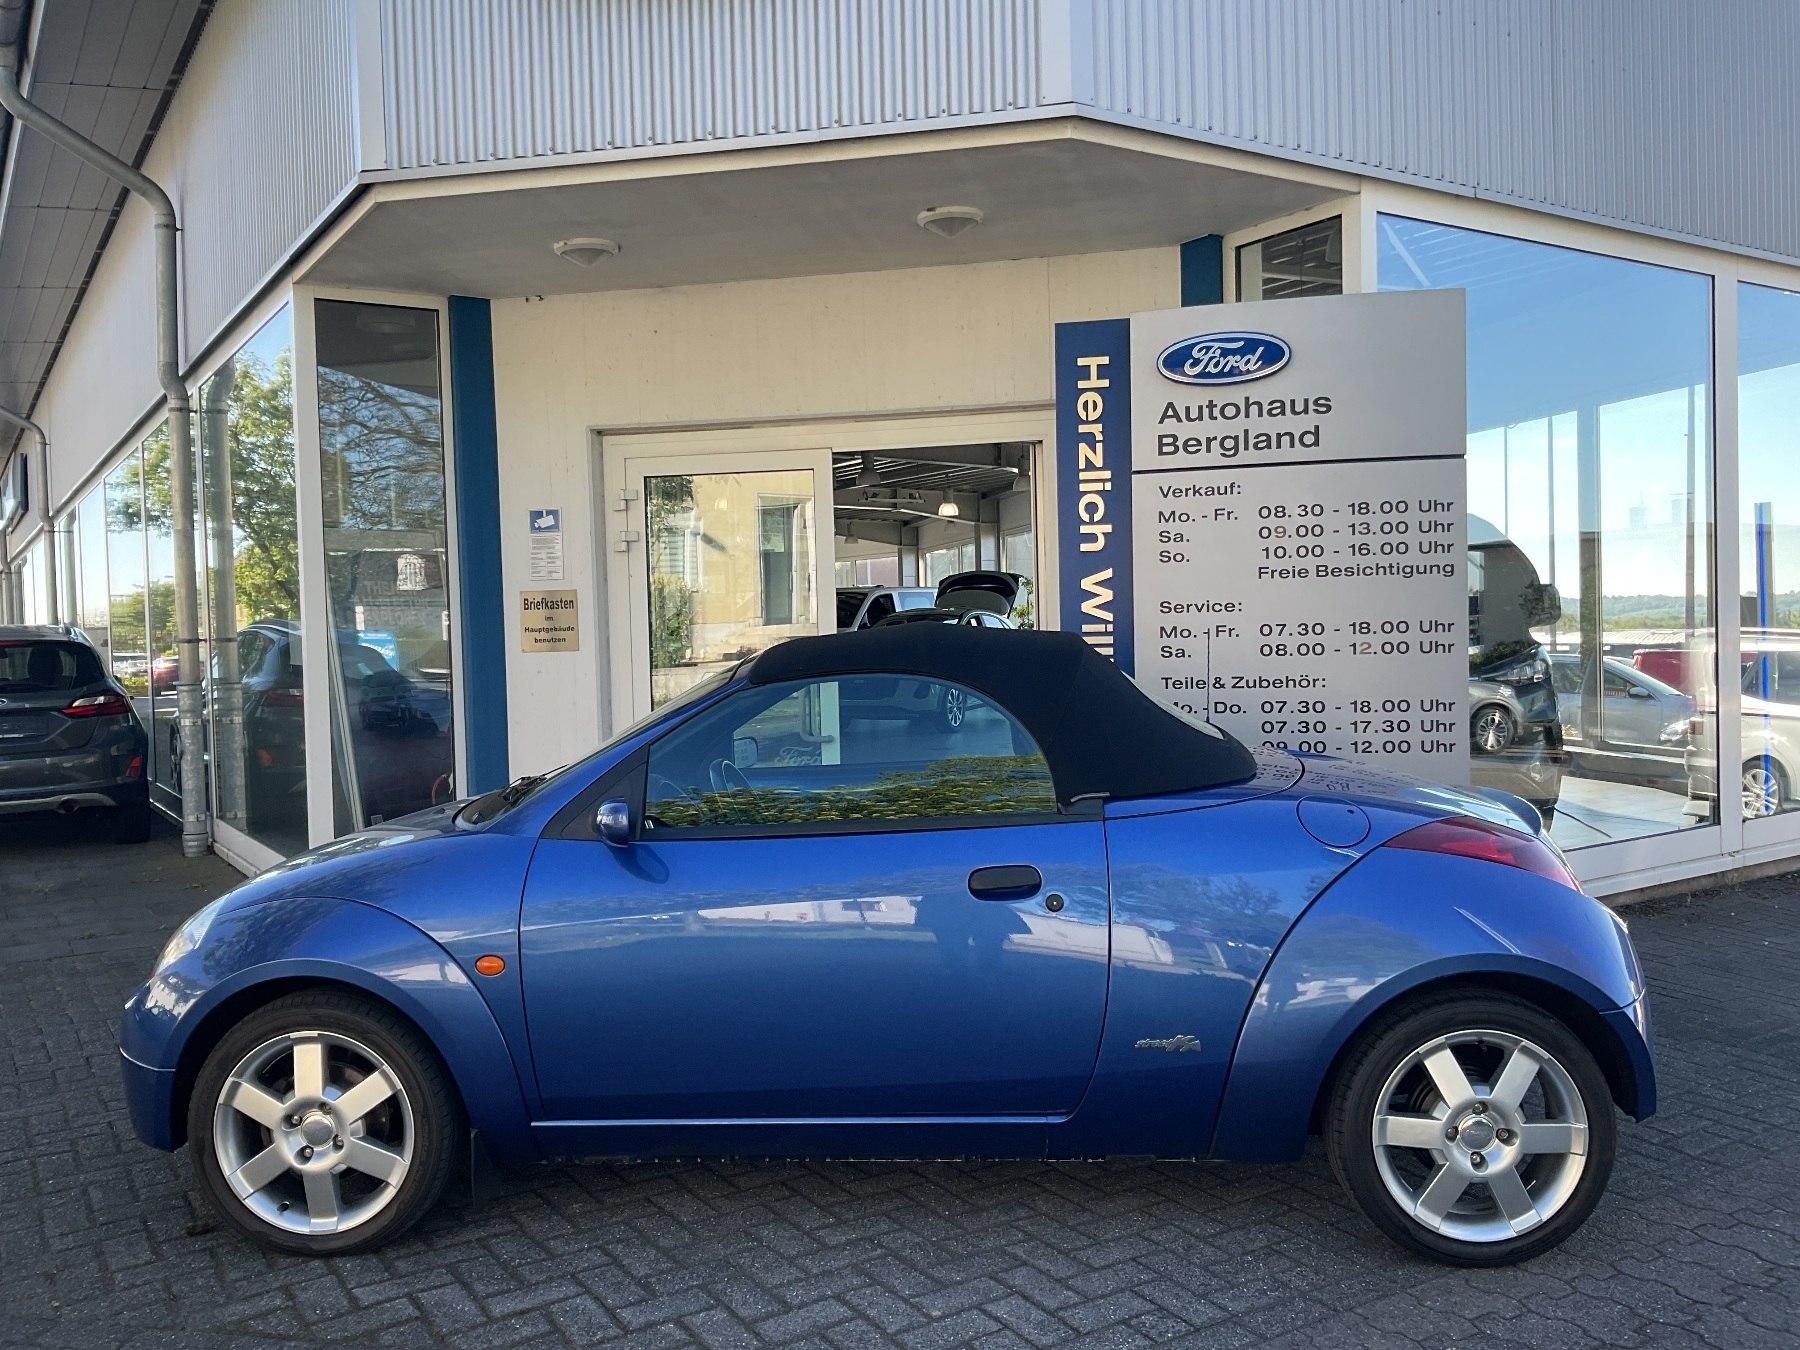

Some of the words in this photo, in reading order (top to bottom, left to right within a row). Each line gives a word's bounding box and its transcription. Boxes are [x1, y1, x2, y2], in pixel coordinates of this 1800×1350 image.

[1184, 340, 1264, 375] Ford
[1158, 397, 1332, 425] Autohaus
[1158, 425, 1320, 458] Bergland
[1076, 355, 1113, 552] Herzlich
[1158, 481, 1241, 499] Verkauf:
[1158, 510, 1196, 524] Mo.
[1214, 507, 1238, 522] Fr.
[1258, 503, 1325, 520] 08.30
[1347, 500, 1409, 516] 18.00
[1418, 499, 1454, 514] Uhr
[1158, 530, 1190, 544] Sa.
[1258, 523, 1325, 540] 09.00
[1347, 520, 1409, 536] 13.00
[1418, 519, 1455, 534] Uhr
[1158, 549, 1190, 564] So.
[1261, 544, 1325, 560] 10.00
[1347, 541, 1409, 557] 16.00
[1418, 540, 1455, 555] Uhr
[1257, 565, 1310, 580] Freie
[1315, 562, 1455, 579] Besichtigung
[523, 598, 575, 611] Briefkasten
[1159, 599, 1243, 615] Service:
[1080, 567, 1115, 663] Will
[524, 625, 575, 634] Hauptgebäude
[1159, 625, 1198, 639] Mo.
[1215, 624, 1240, 638] Fr.
[1259, 622, 1325, 637] 07.30
[1348, 620, 1410, 635] 18.00
[1419, 619, 1455, 634] Uhr
[534, 636, 567, 644] benutzen
[1160, 645, 1192, 659] Sa.
[1259, 642, 1326, 657] 08.00
[1348, 640, 1410, 656] 12.00
[1419, 640, 1455, 654] Uhr
[1160, 676, 1207, 690] Teile
[1211, 676, 1226, 690] &
[1230, 674, 1326, 689] Zubehör:
[1171, 702, 1197, 715] o.
[1213, 701, 1247, 715] Do.
[1260, 700, 1326, 714] 07.30
[1349, 699, 1411, 714] 18.00
[1420, 698, 1456, 713] Uhr
[1260, 720, 1327, 734] 07.30
[1349, 719, 1411, 734] 17.30
[1420, 719, 1456, 733] Uhr
[1349, 739, 1412, 754] 12.00
[1420, 739, 1457, 754] Uhr
